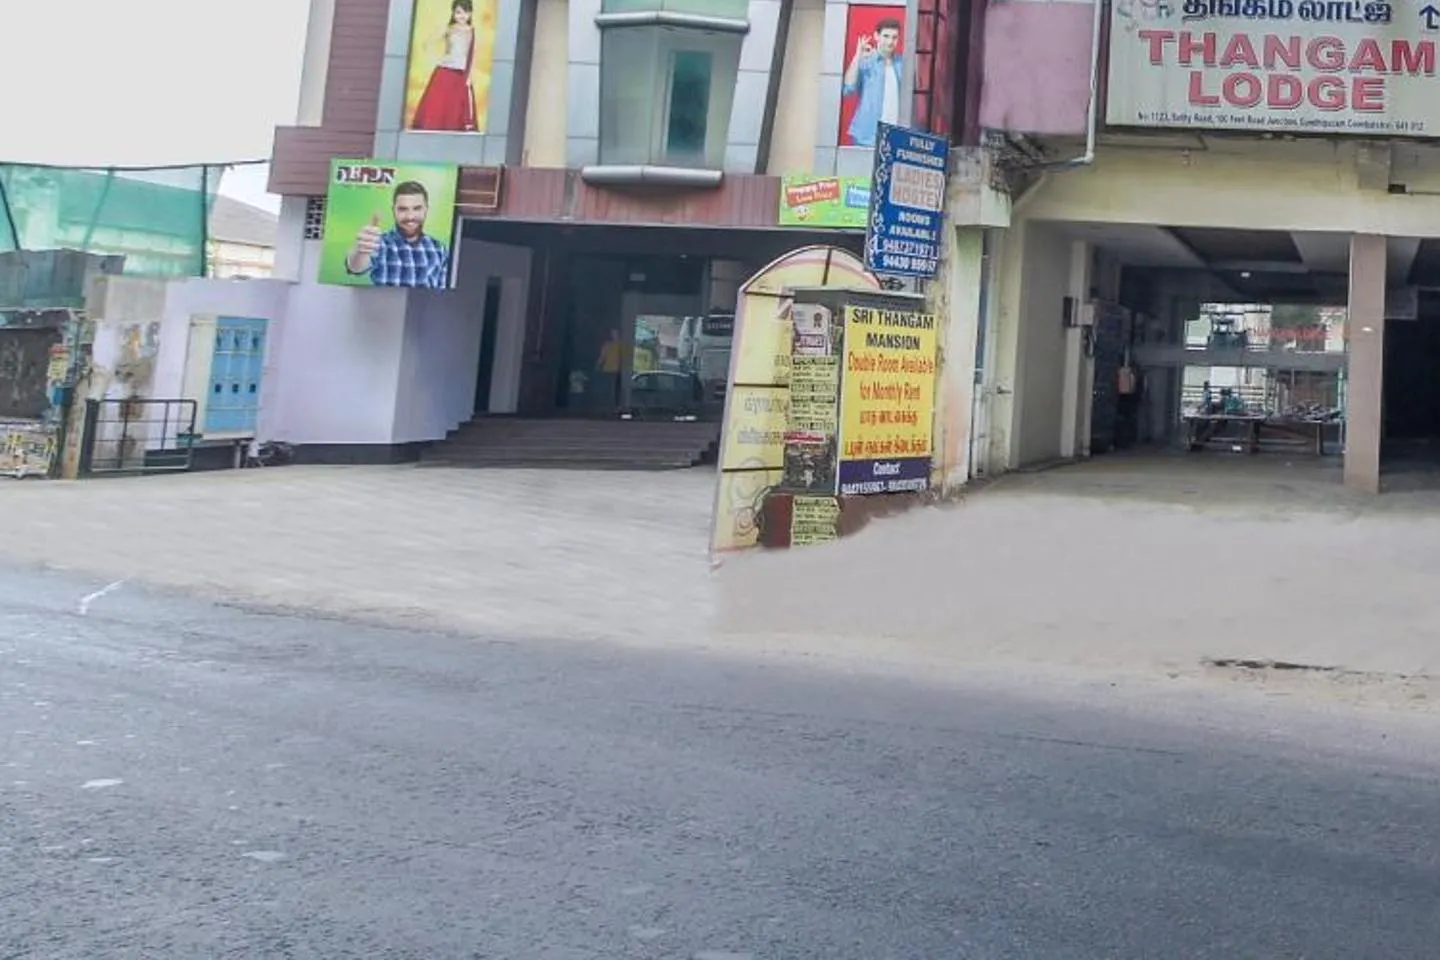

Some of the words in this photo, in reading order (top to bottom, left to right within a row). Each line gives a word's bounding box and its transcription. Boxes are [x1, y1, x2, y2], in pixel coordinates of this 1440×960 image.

[1138, 29, 1436, 77] THANGAM
[1188, 72, 1384, 113] LODGE
[852, 308, 873, 325] SRI
[877, 310, 934, 330] THANGAM
[865, 332, 920, 350] MANSION
